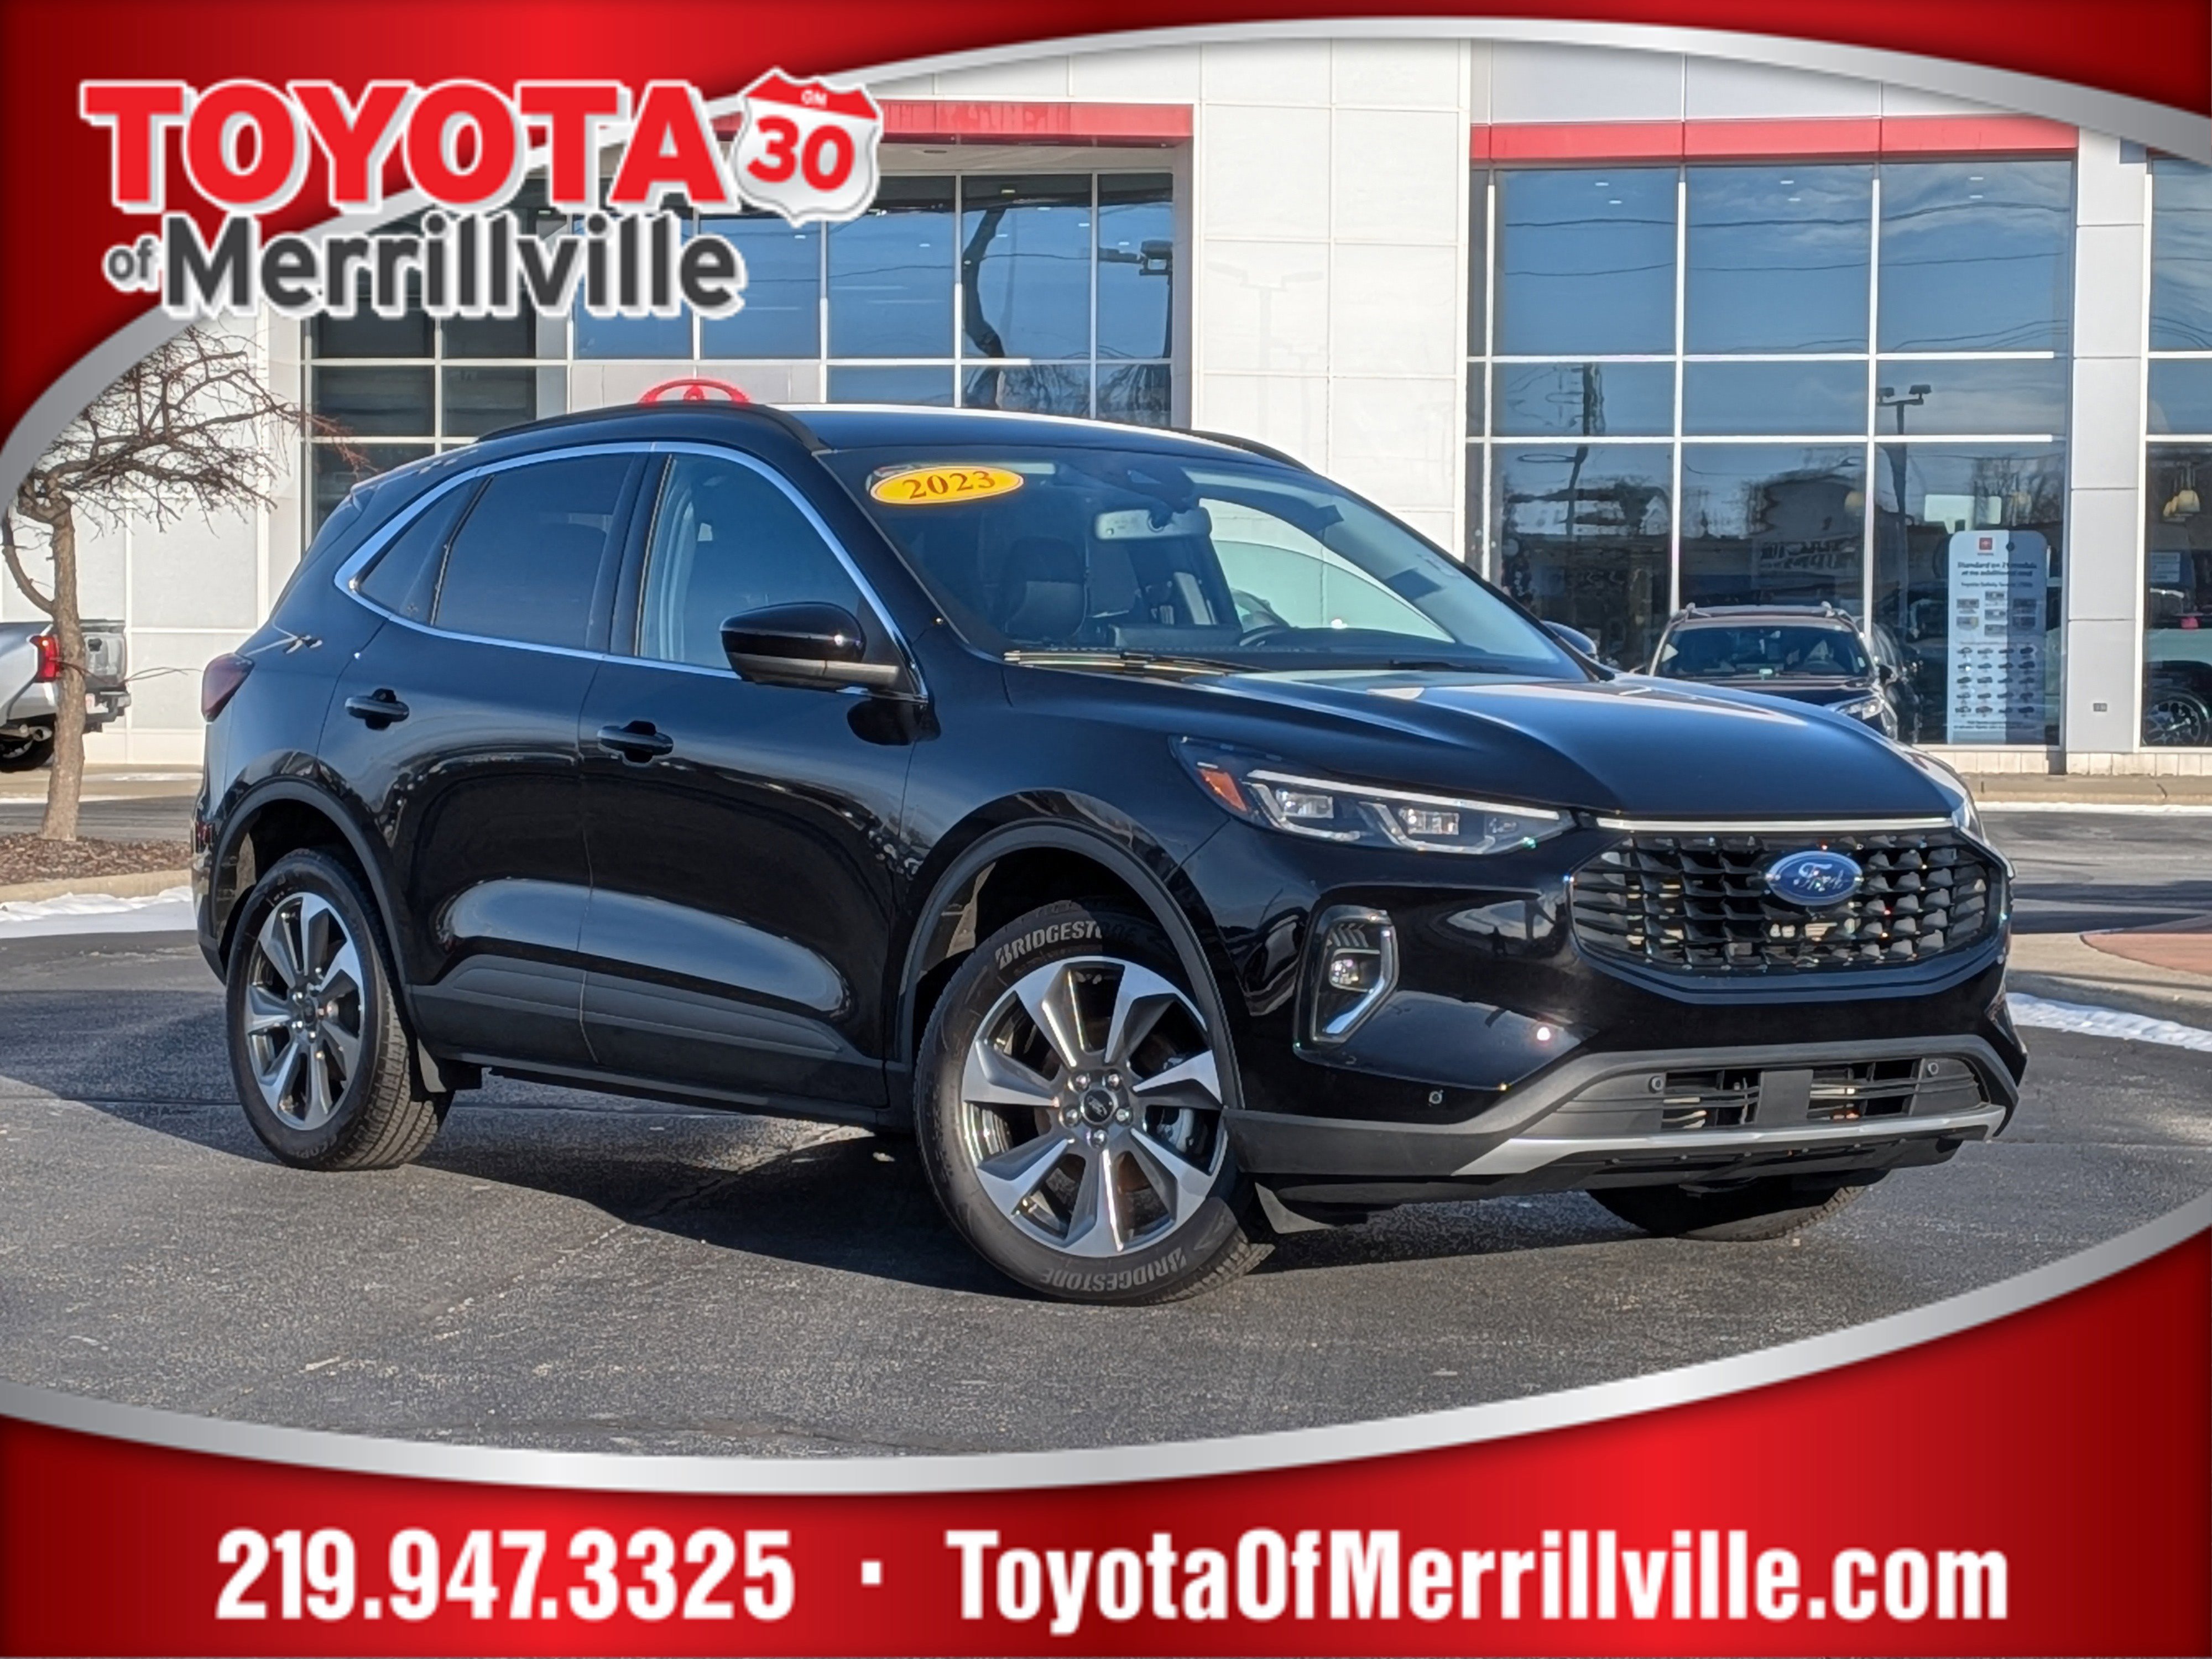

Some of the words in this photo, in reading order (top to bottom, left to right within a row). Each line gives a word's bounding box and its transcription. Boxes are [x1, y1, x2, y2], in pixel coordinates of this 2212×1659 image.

[902, 471, 995, 499] 2023
[995, 920, 1103, 970] BRIDGEST
[1040, 1246, 1187, 1292] BRIDGESTONE
